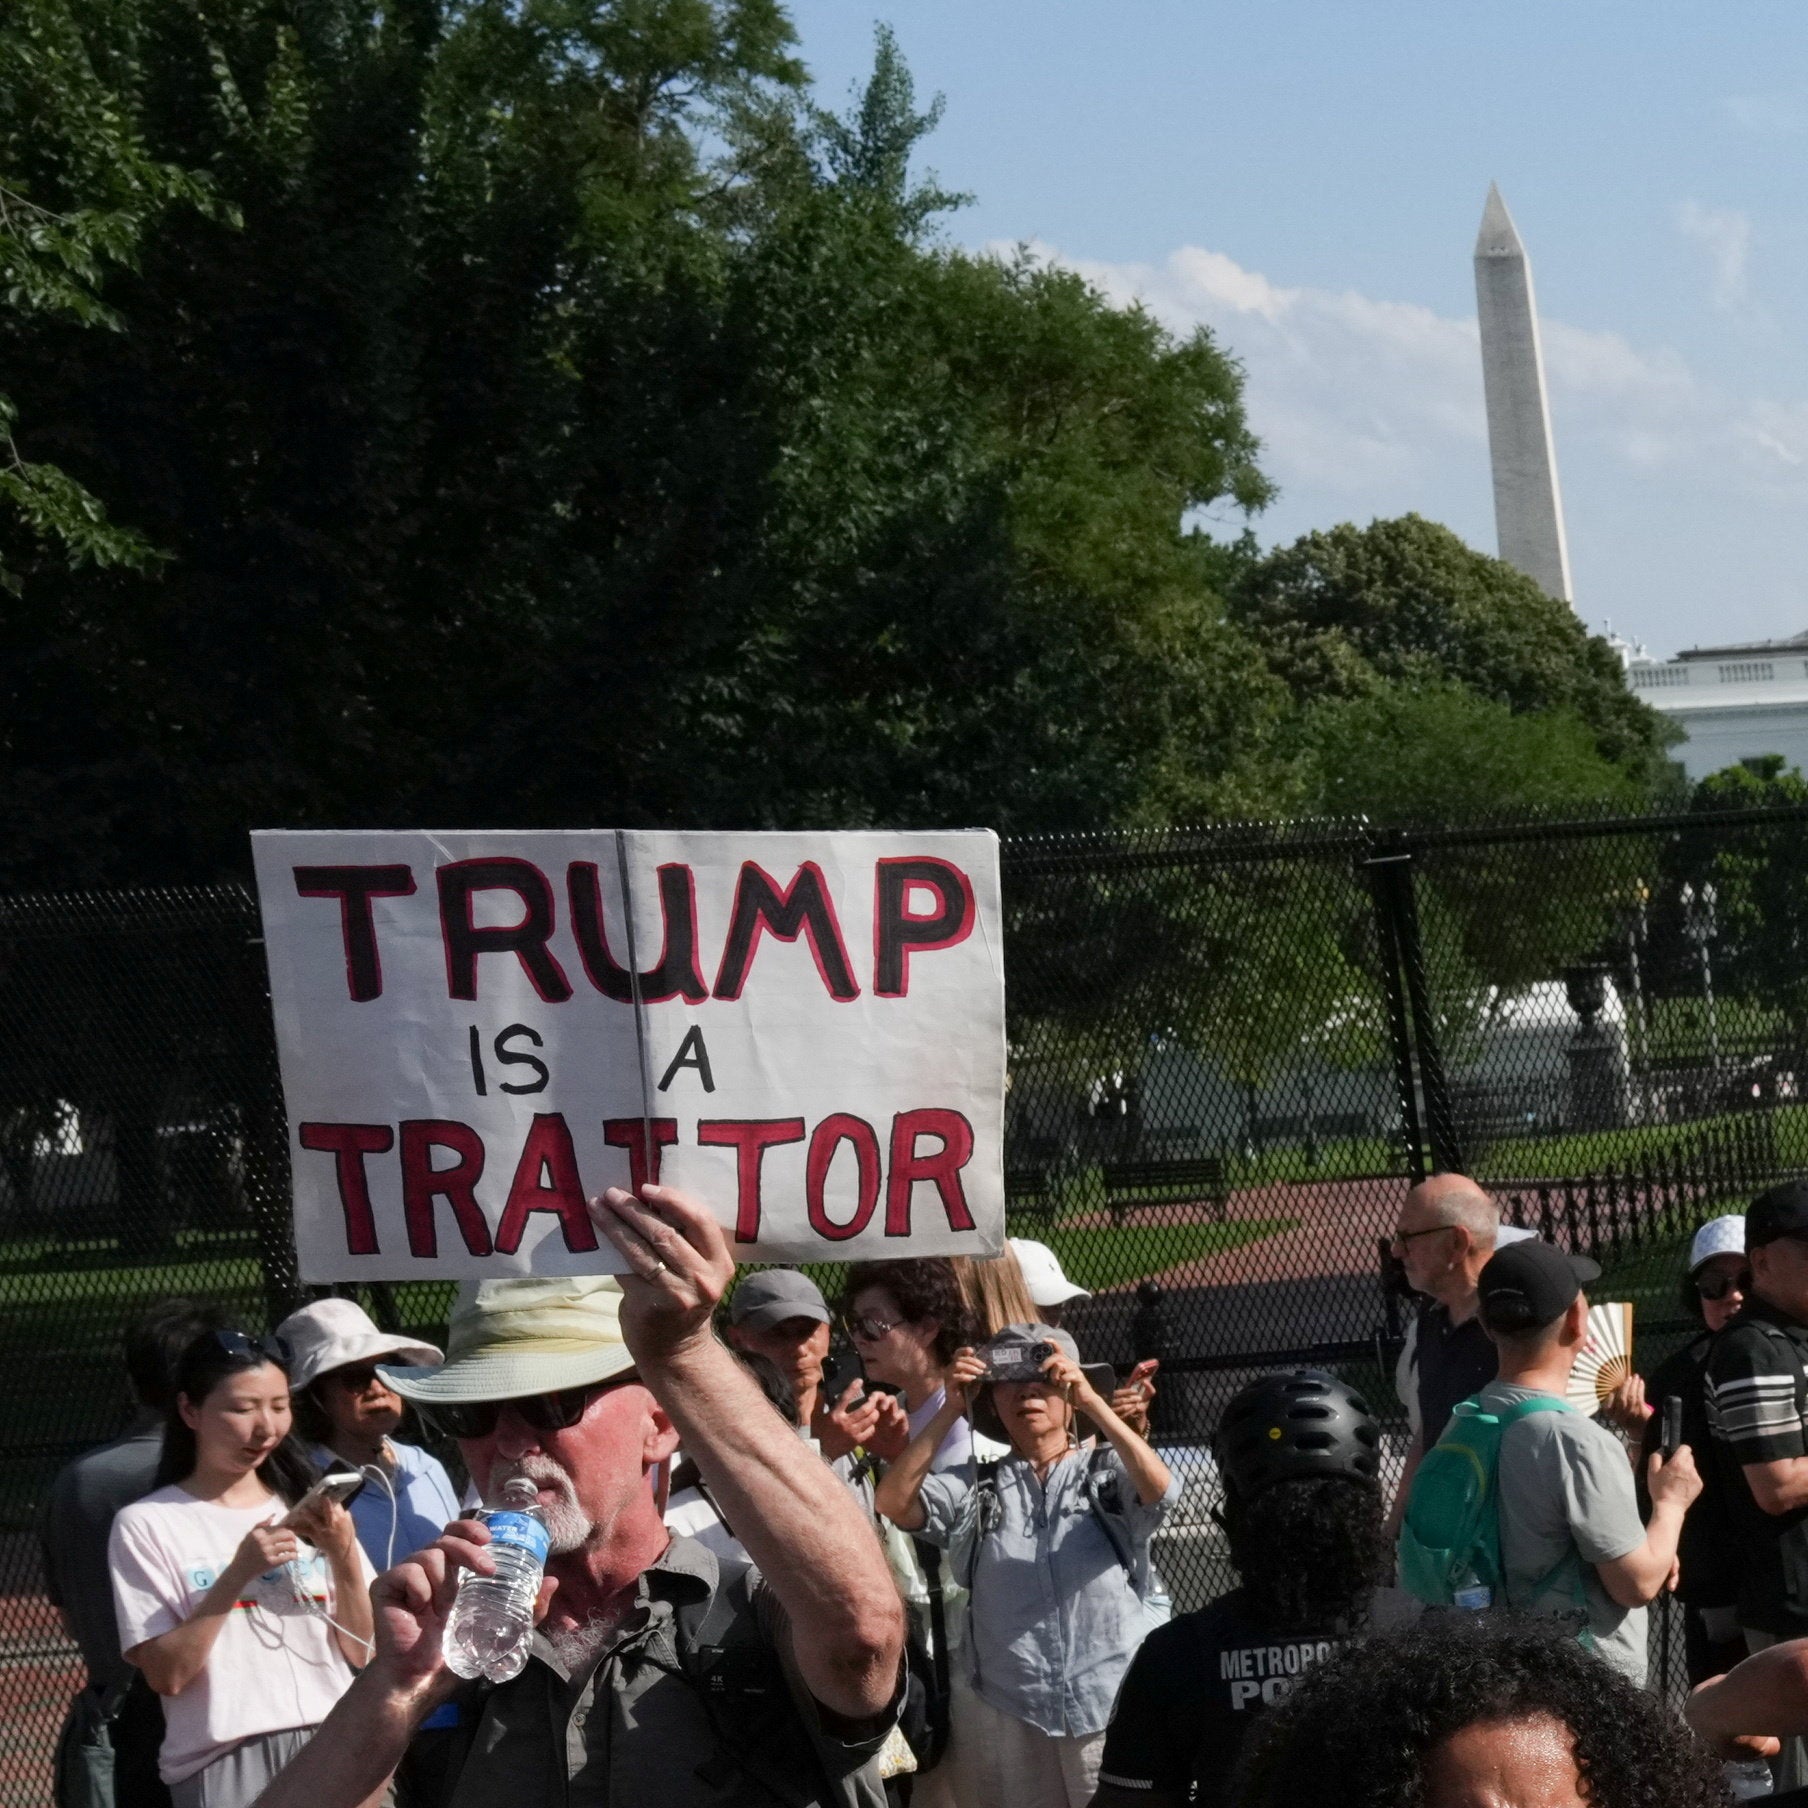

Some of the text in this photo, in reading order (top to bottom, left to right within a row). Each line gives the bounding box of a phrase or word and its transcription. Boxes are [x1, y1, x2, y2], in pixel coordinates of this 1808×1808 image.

[292, 855, 976, 1004] TRUMP
[469, 1024, 715, 1096] IS A
[1220, 1641, 1339, 1680] METROPO
